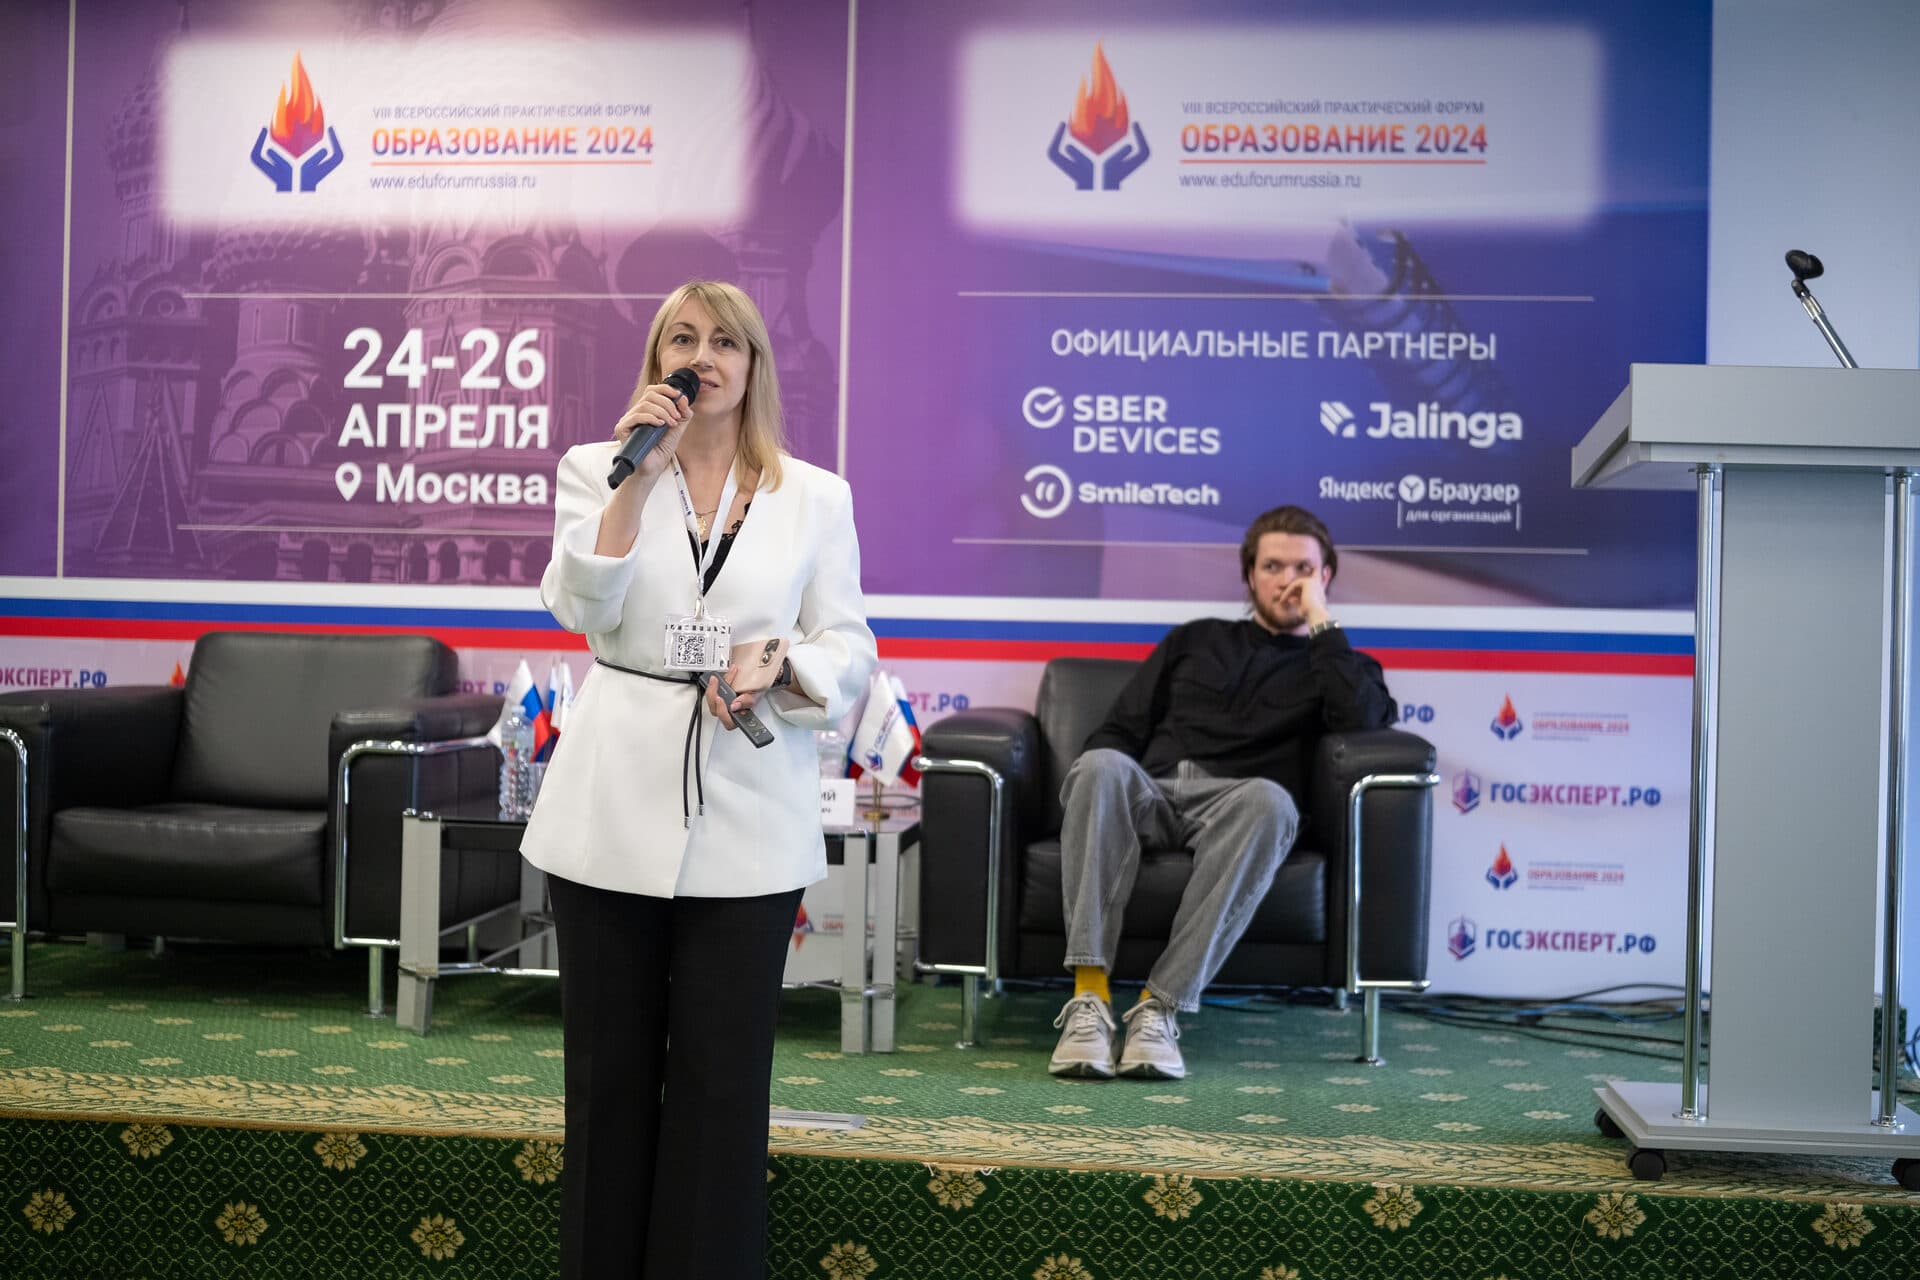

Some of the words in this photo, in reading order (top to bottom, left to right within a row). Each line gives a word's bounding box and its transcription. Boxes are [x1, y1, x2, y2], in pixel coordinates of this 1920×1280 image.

[372, 106, 391, 119] VIII
[394, 104, 501, 119] ВСЕРОССИЙСКИЙ
[504, 103, 601, 118] ПРАКТИЧЕСКИЙ
[606, 104, 651, 118] ФОРУМ
[1181, 101, 1201, 114] VIII
[1205, 99, 1321, 114] ВСЕРОССИЙСКИЙ
[1324, 99, 1431, 114] ПРАКТИЧЕСКИЙ
[1435, 101, 1485, 114] ФОРУМ
[372, 126, 578, 156] ОБРАЗОВАНИЕ
[587, 126, 654, 155] 2024
[1181, 123, 1406, 153] ОБРАЗОВАНИЕ
[1415, 123, 1488, 153] 2024
[370, 173, 537, 189] www.eduforumrussia.ru
[1179, 172, 1362, 188] www.eduforumrussia.ru
[343, 327, 546, 390] 24-26
[1051, 329, 1309, 361] ОФИЦИАЛЬНЫЕ
[1317, 332, 1496, 360] ПАРТНЕРЫ
[1073, 395, 1167, 423] SBER
[337, 403, 549, 449] АПРЕЛЯ
[1366, 402, 1523, 448] Jalinga
[1073, 427, 1221, 455] DEVICES
[375, 463, 549, 505] Москва
[1078, 482, 1220, 506] SmileTech
[1319, 476, 1395, 502] Яндекс
[1428, 478, 1520, 505] Браузер
[1405, 510, 1430, 523] для
[1431, 509, 1512, 524] организаций
[1490, 783, 1662, 807] ГОСЭКСПЕРТ.РФ
[1486, 929, 1657, 954] ГОСЭКСПЕРТ.РФ
